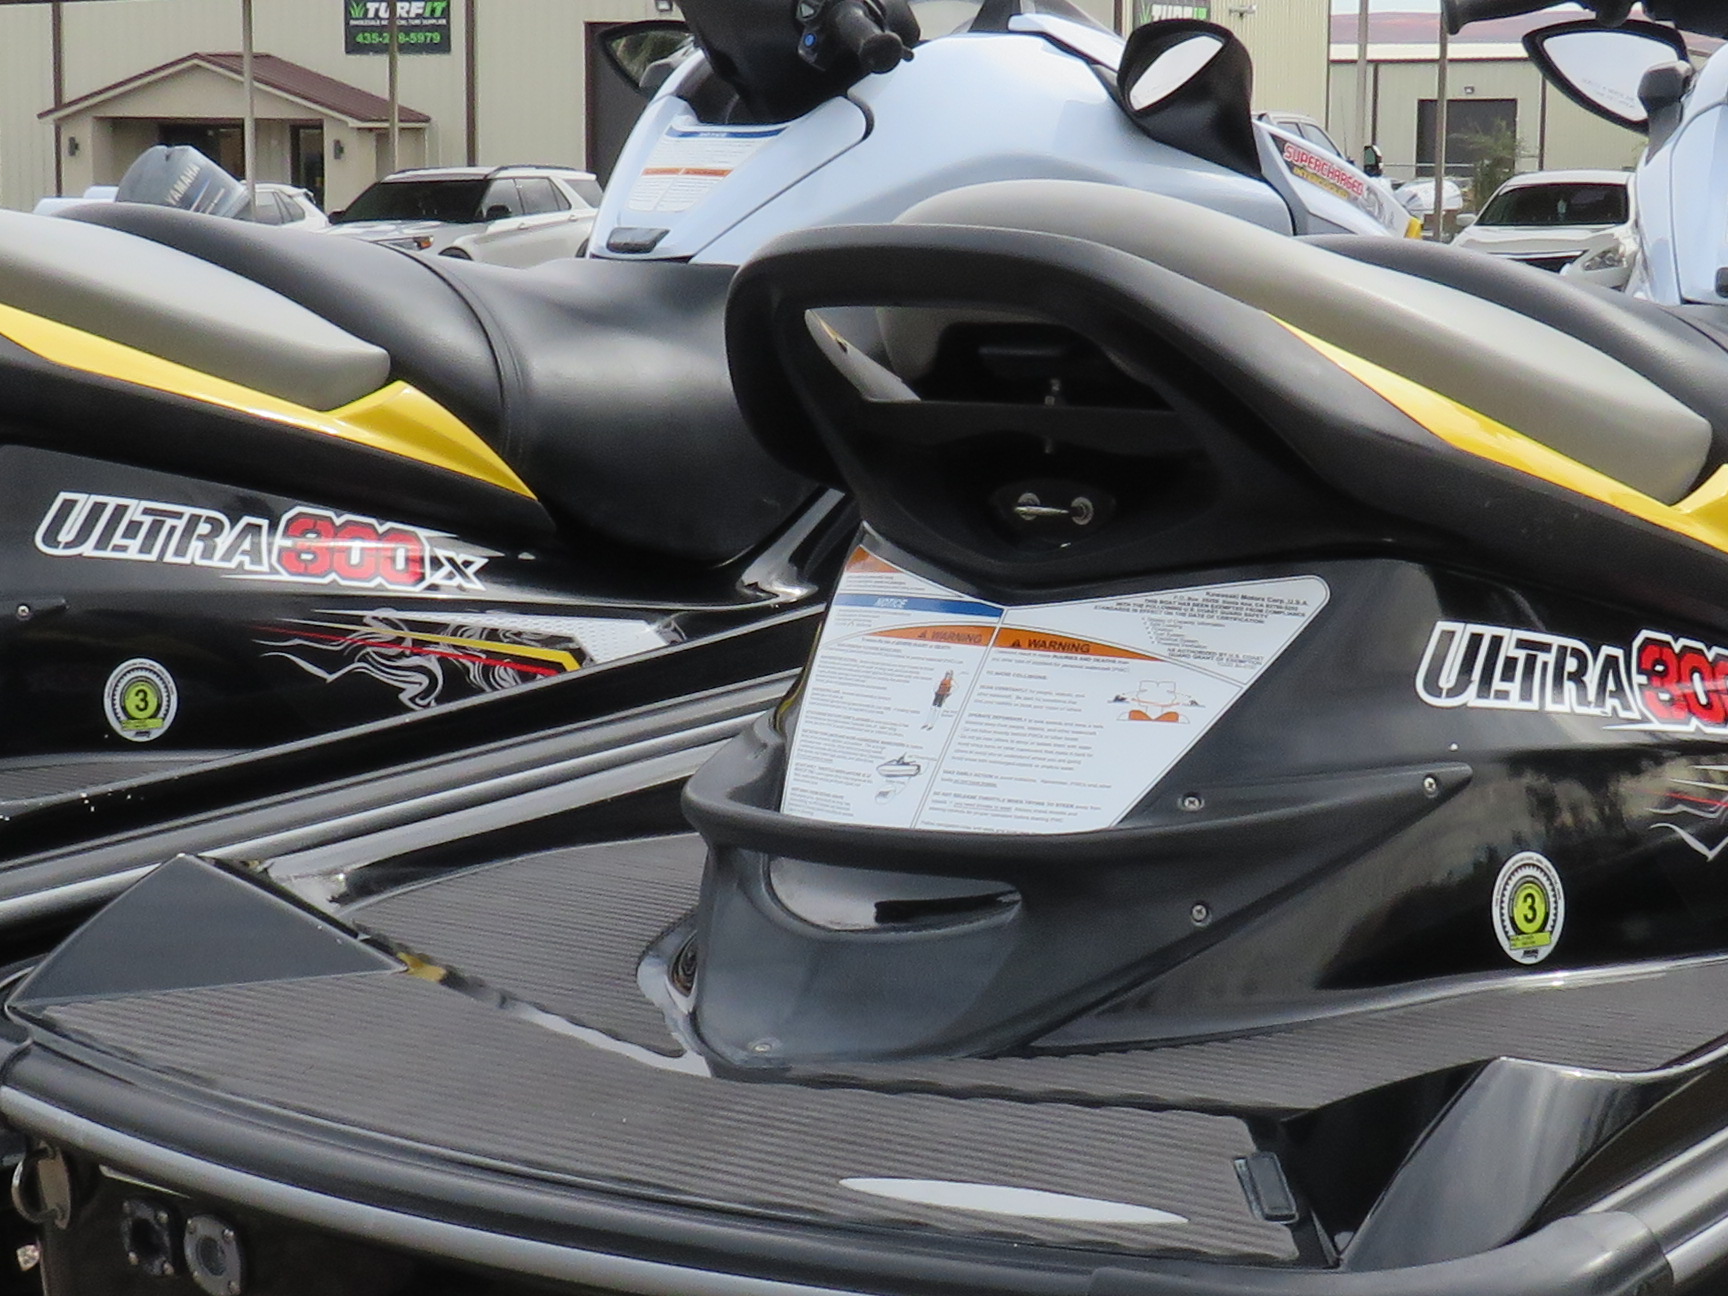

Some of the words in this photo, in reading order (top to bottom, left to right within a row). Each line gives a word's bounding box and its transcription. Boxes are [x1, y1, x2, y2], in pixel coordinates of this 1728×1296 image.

[366, 1, 447, 18] TURFIT
[355, 31, 441, 44] 435-28-5979
[1283, 143, 1366, 197] SUPERCHARGED
[165, 163, 201, 206] YAMAHA
[35, 491, 269, 572] ULTRA
[931, 630, 983, 644] WARNING
[1028, 638, 1091, 654] WARNING
[1415, 620, 1641, 719] ULTRA
[135, 689, 149, 711] 3
[1523, 892, 1538, 924] 3
